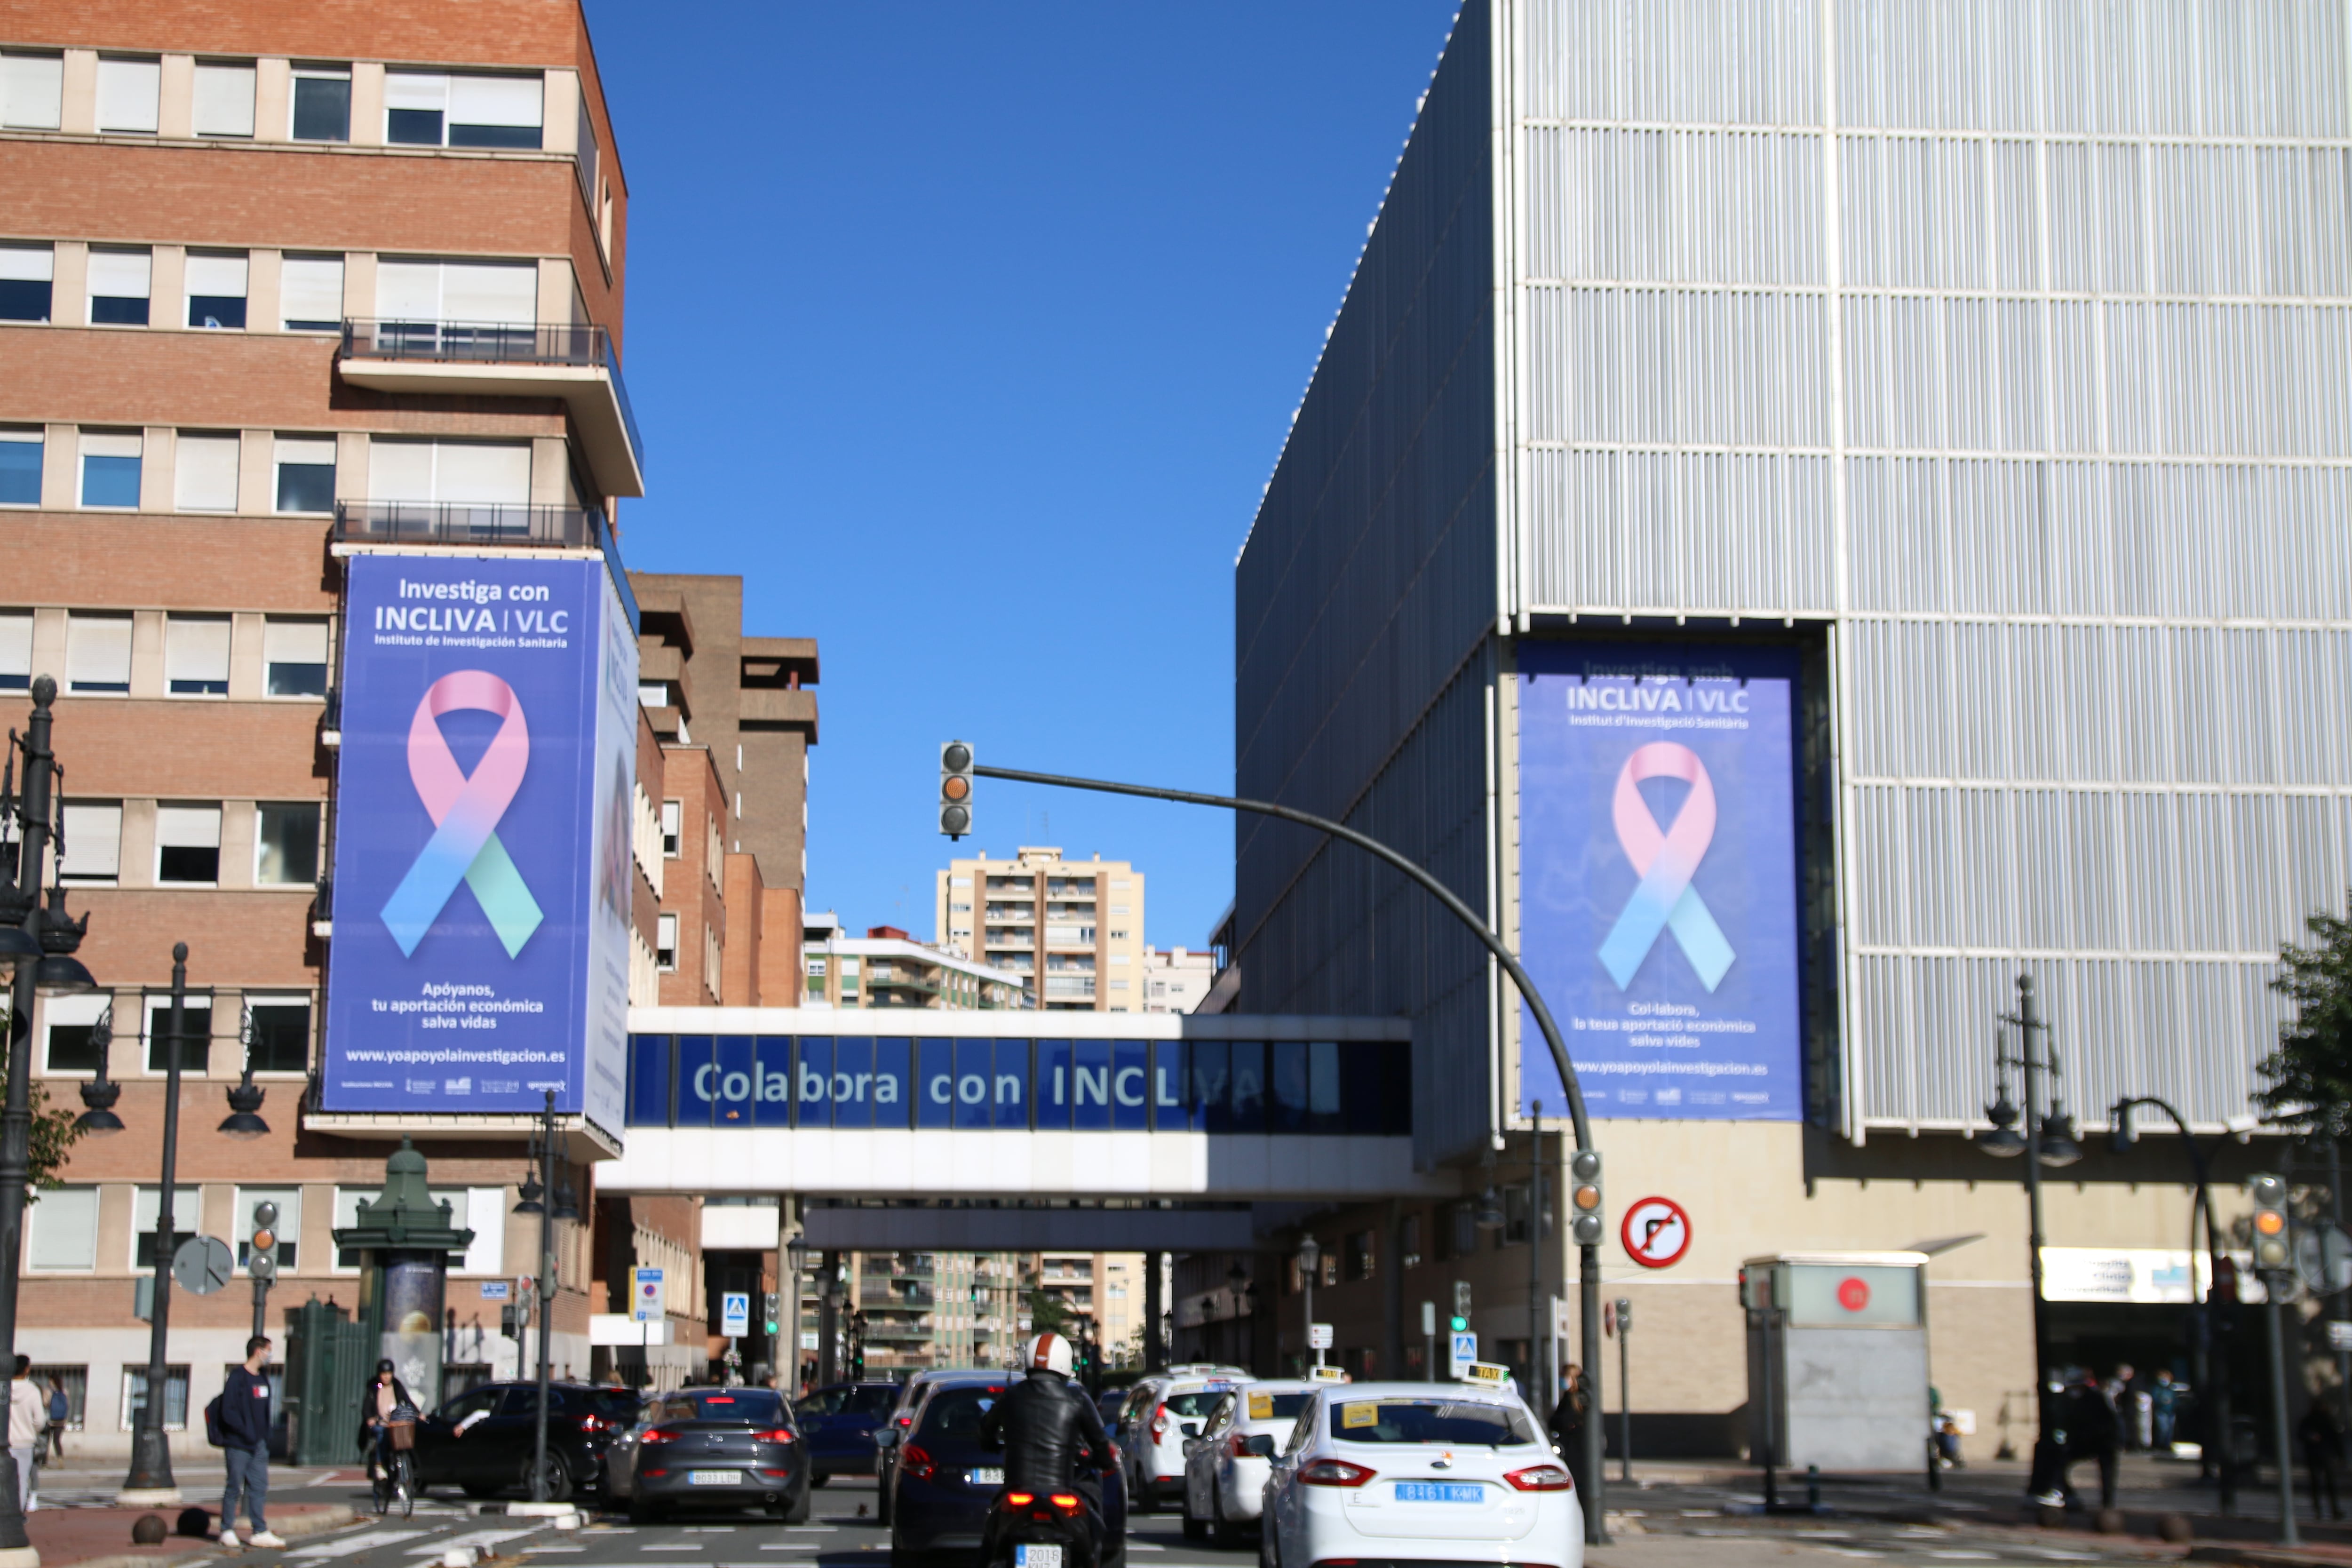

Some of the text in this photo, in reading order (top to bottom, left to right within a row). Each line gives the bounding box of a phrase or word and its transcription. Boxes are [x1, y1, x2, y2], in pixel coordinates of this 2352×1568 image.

[400, 579, 549, 604] Investiga con
[376, 607, 568, 634] INCLIVA VLC
[374, 634, 567, 649] Instituto de Investigación Sanitaria
[1567, 687, 1749, 713] INCLIVA VLC
[1571, 715, 1613, 726] Institut
[422, 982, 495, 1000] Apóyanos,
[372, 998, 543, 1014] tu aportación económica
[421, 1015, 497, 1029] salva vidas
[1574, 1019, 1586, 1030] la
[1589, 1019, 1618, 1031] teua
[1622, 1018, 1683, 1032] aportació
[1629, 1035, 1700, 1048] salva vides
[347, 1048, 565, 1065] www.yoapoyolainvestigacion.es
[694, 1061, 898, 1103] Colabora
[931, 1072, 1020, 1104] con
